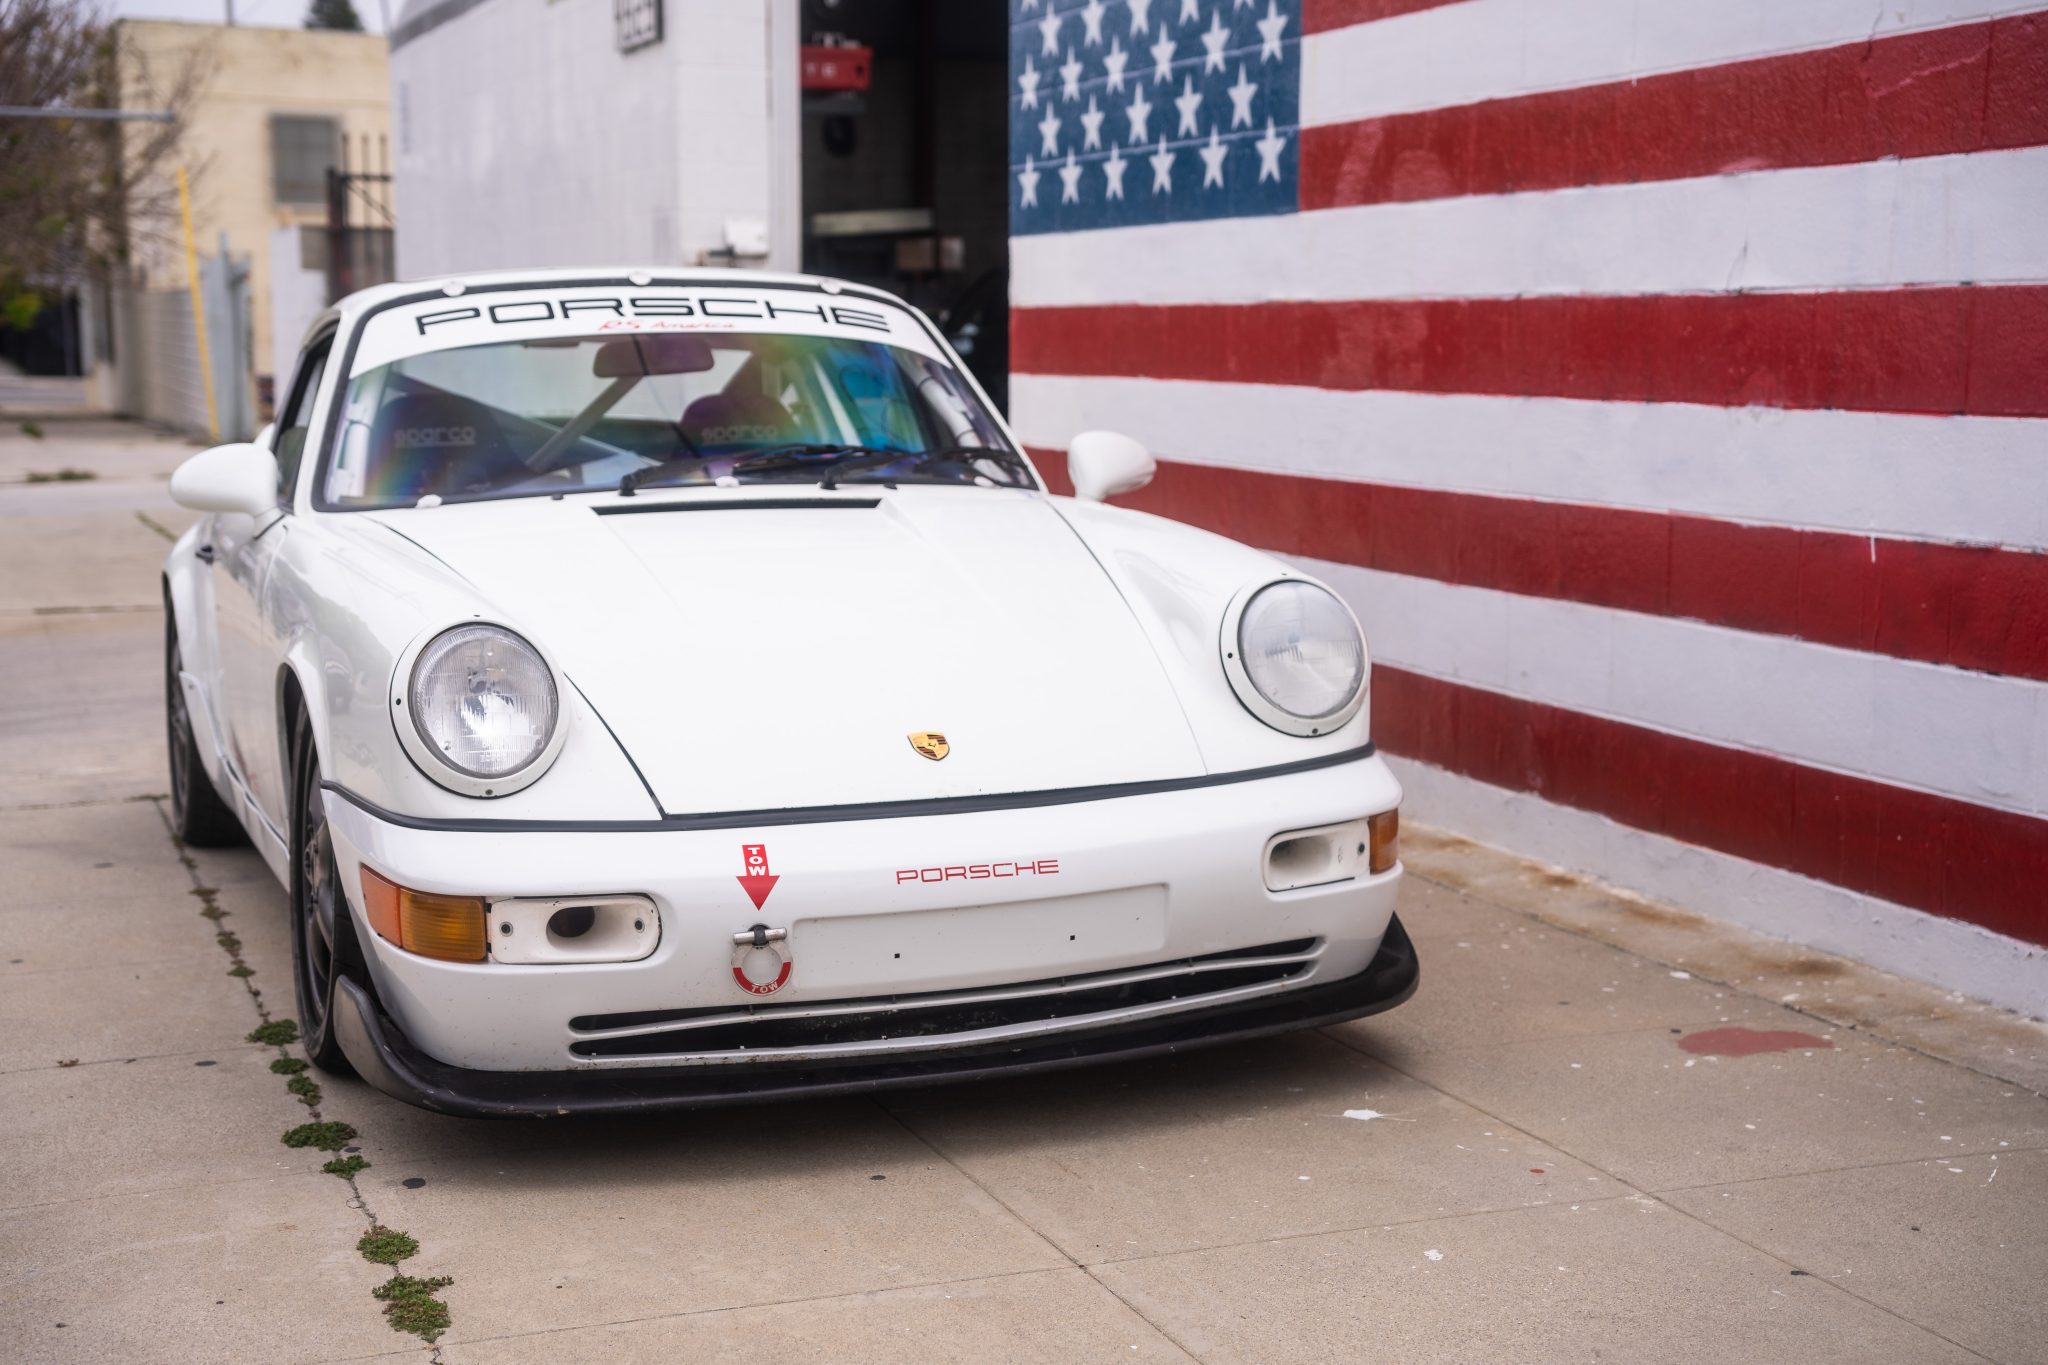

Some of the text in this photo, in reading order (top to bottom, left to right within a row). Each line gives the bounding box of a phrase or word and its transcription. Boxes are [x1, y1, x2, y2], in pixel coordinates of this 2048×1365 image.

[416, 297, 891, 336] PORSCHE
[393, 426, 477, 447] sparco
[748, 847, 767, 877] TOW
[896, 860, 1060, 884] PORSCHE
[752, 981, 779, 994] TOW
